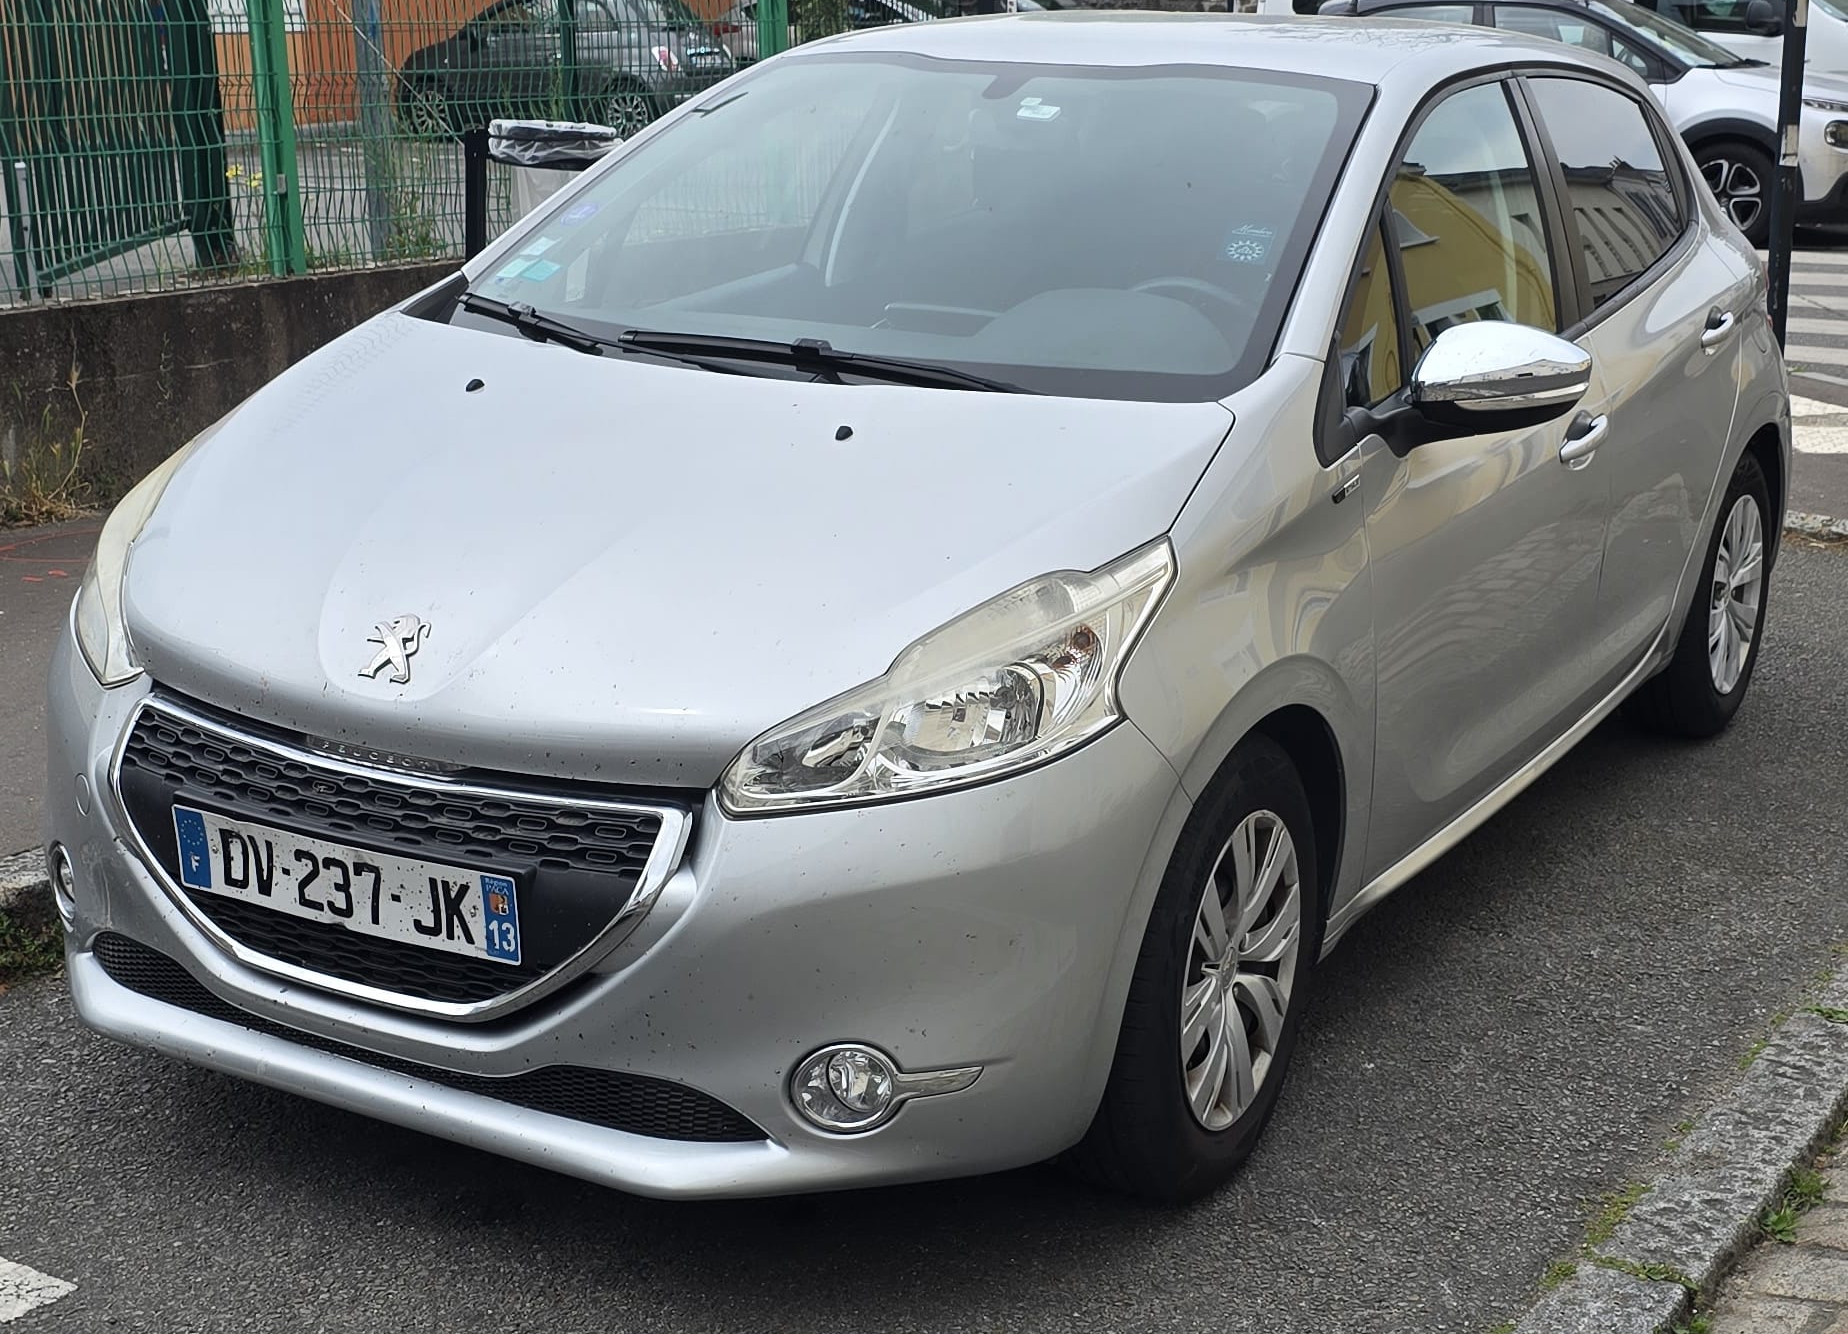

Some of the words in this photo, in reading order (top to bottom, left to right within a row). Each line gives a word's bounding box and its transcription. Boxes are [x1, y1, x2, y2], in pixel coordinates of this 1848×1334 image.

[189, 852, 200, 873] F
[485, 884, 509, 896] PACA
[488, 919, 516, 953] 13
